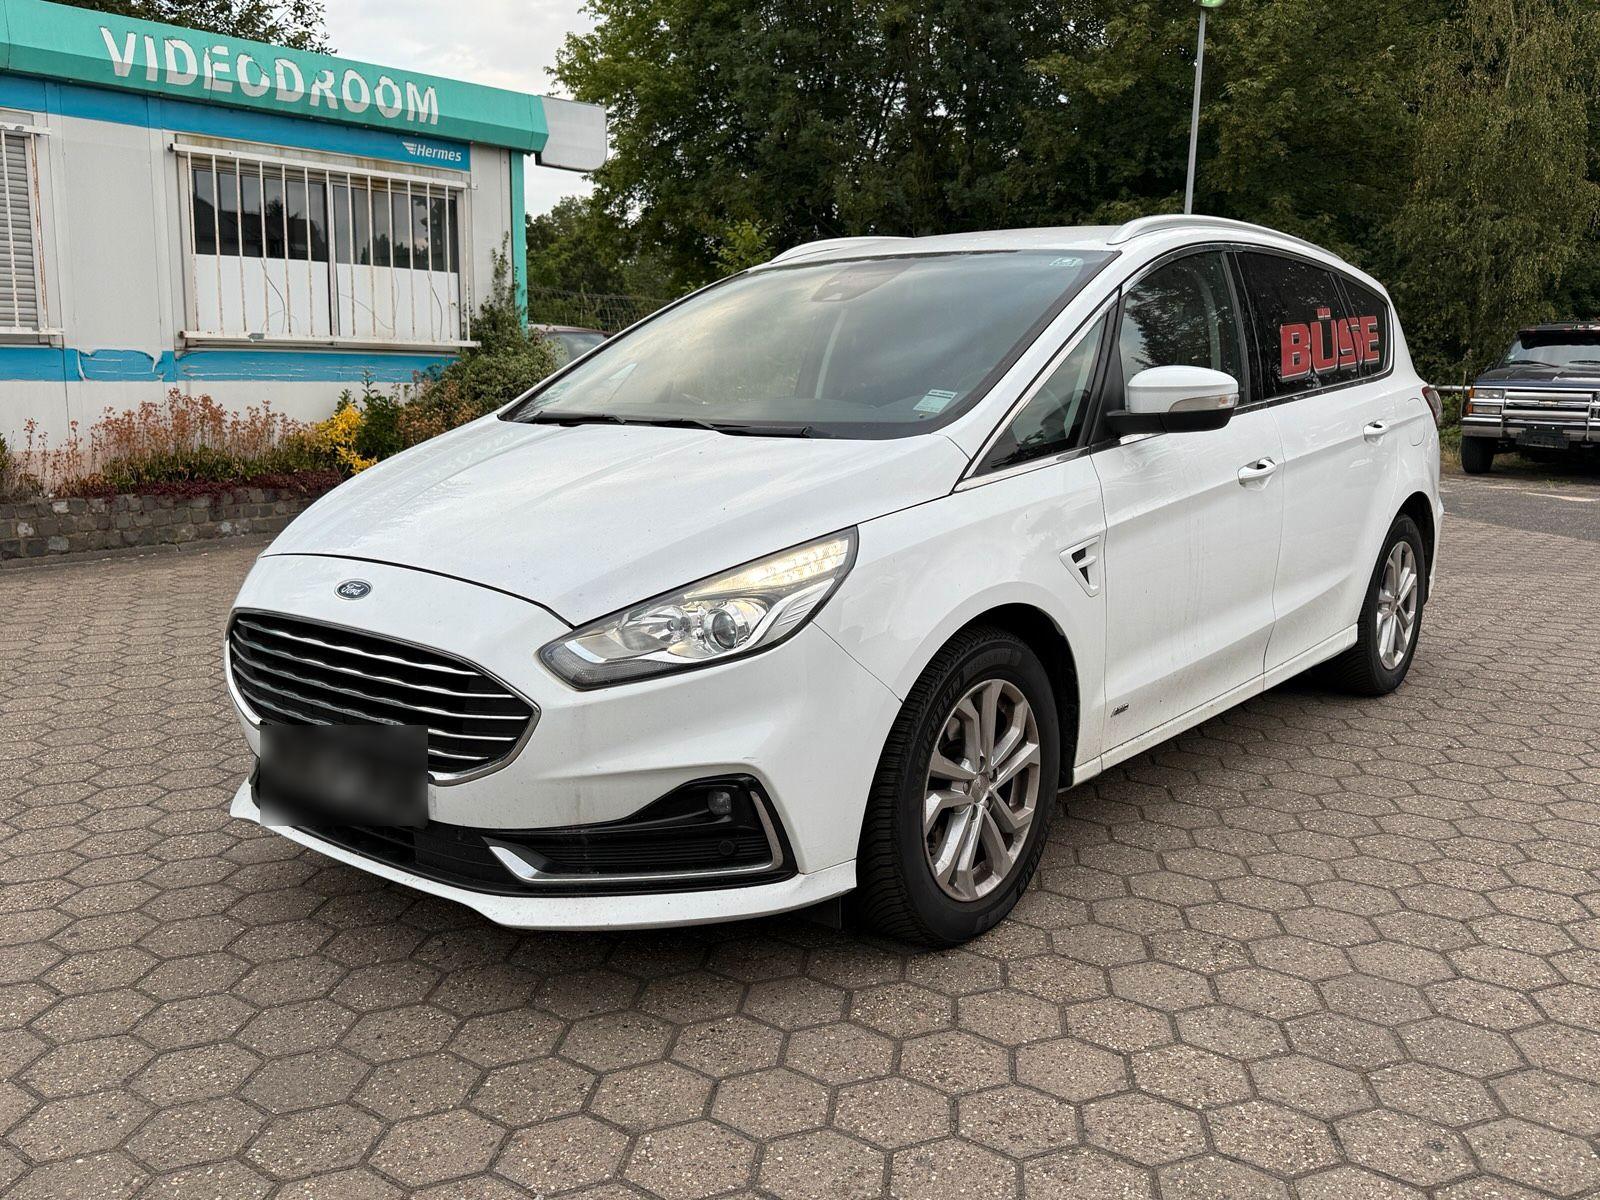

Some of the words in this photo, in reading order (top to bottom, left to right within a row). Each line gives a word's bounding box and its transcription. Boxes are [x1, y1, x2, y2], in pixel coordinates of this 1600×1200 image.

[99, 26, 439, 125] VIDEODROOM
[416, 144, 462, 162] Hermes
[1280, 307, 1379, 381] BÜSE
